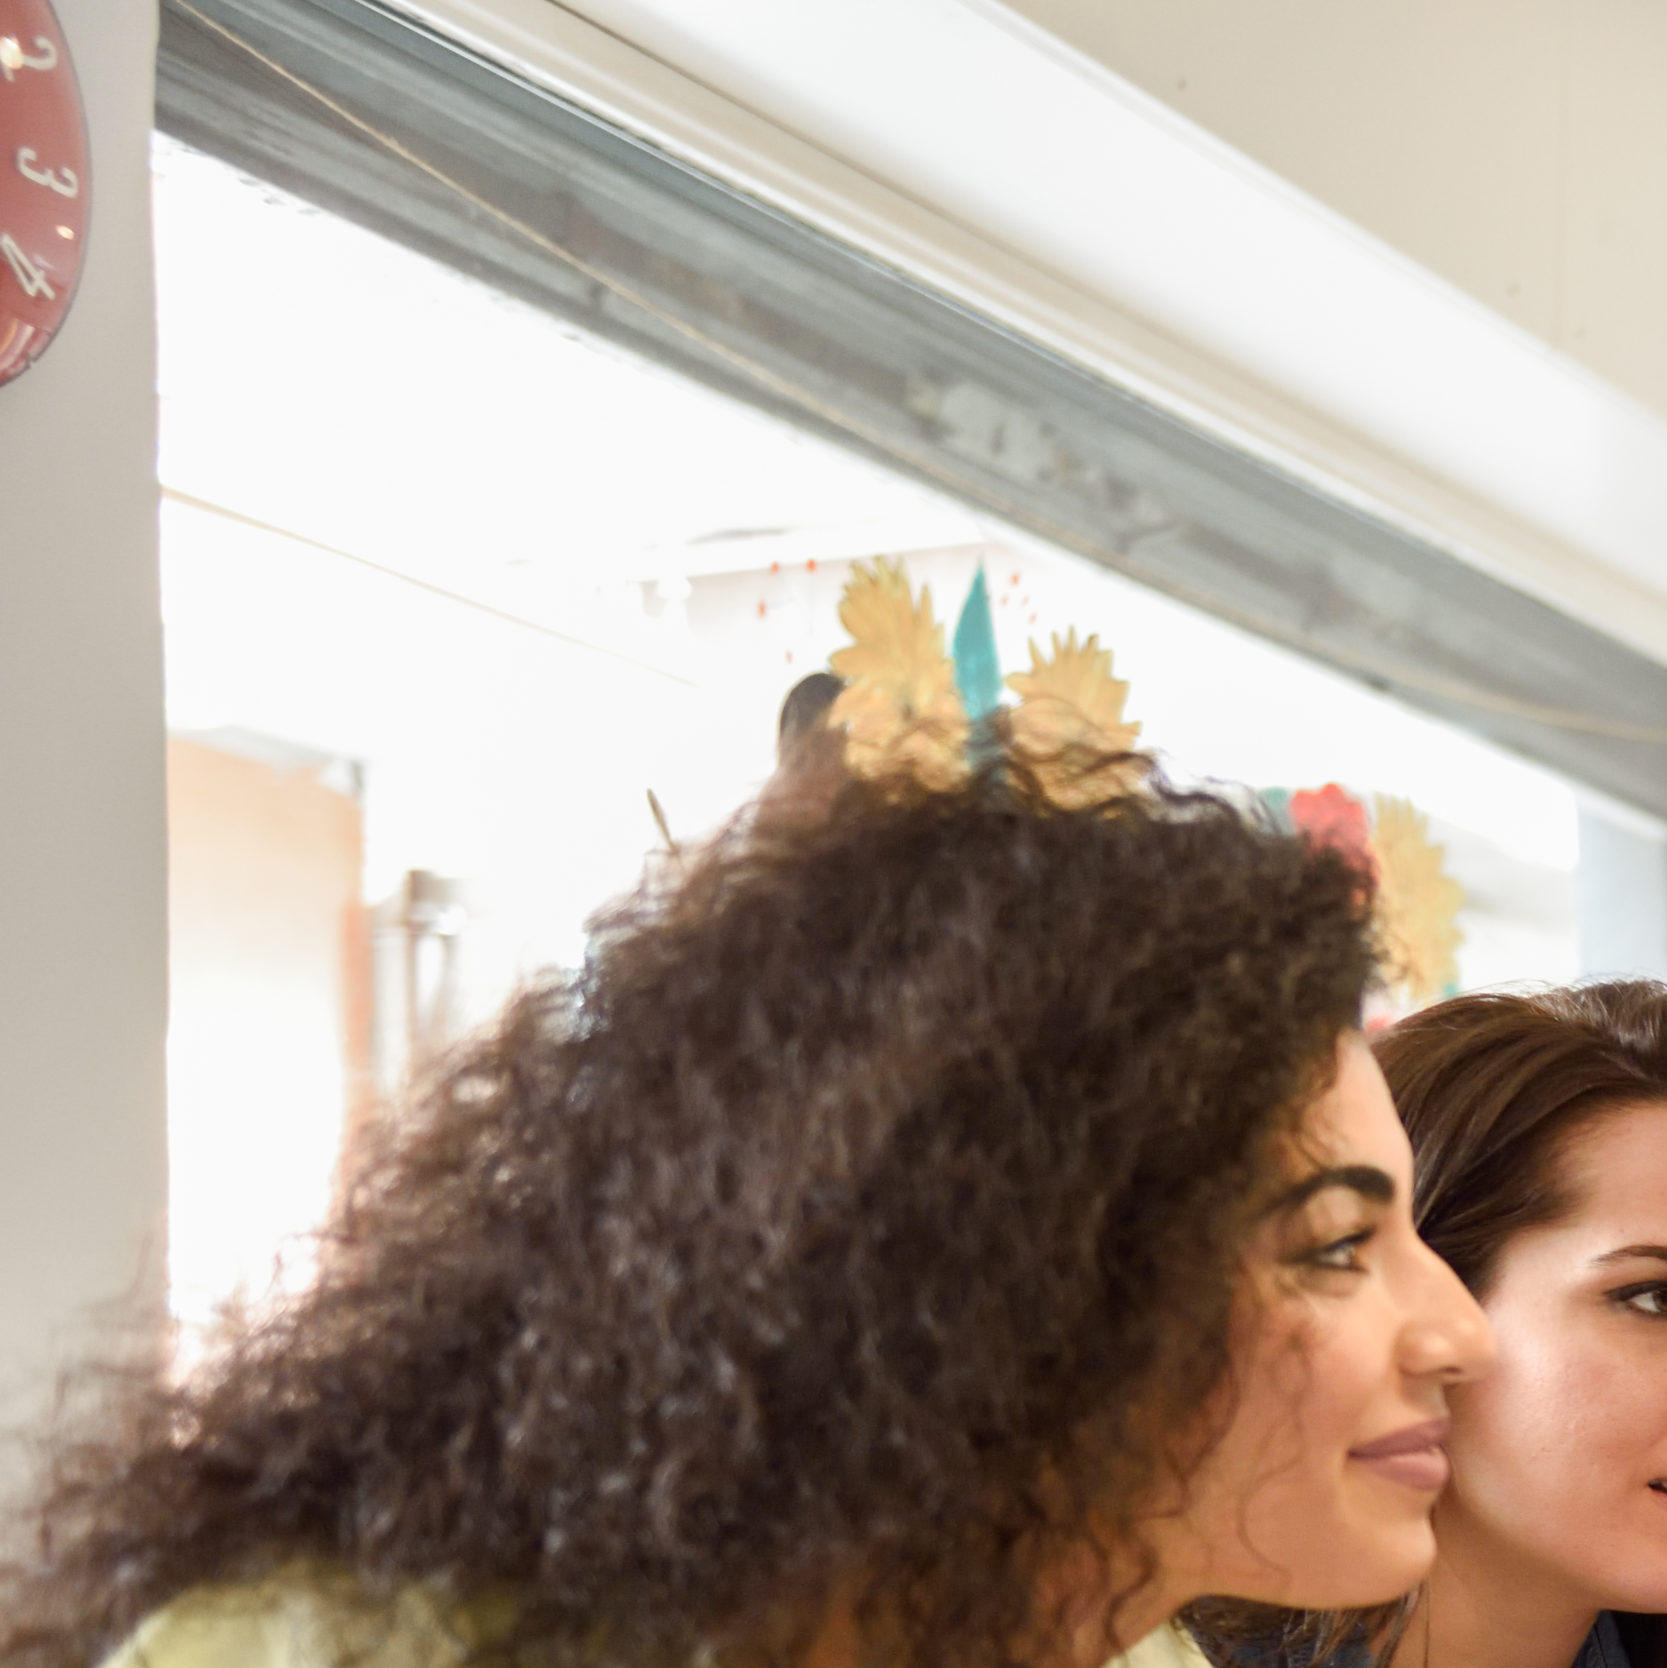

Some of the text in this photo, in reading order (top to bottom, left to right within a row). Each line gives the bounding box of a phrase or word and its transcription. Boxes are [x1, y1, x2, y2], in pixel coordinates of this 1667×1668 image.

[1, 36, 58, 83] 2
[17, 146, 79, 199] 3
[0, 232, 56, 300] 4
